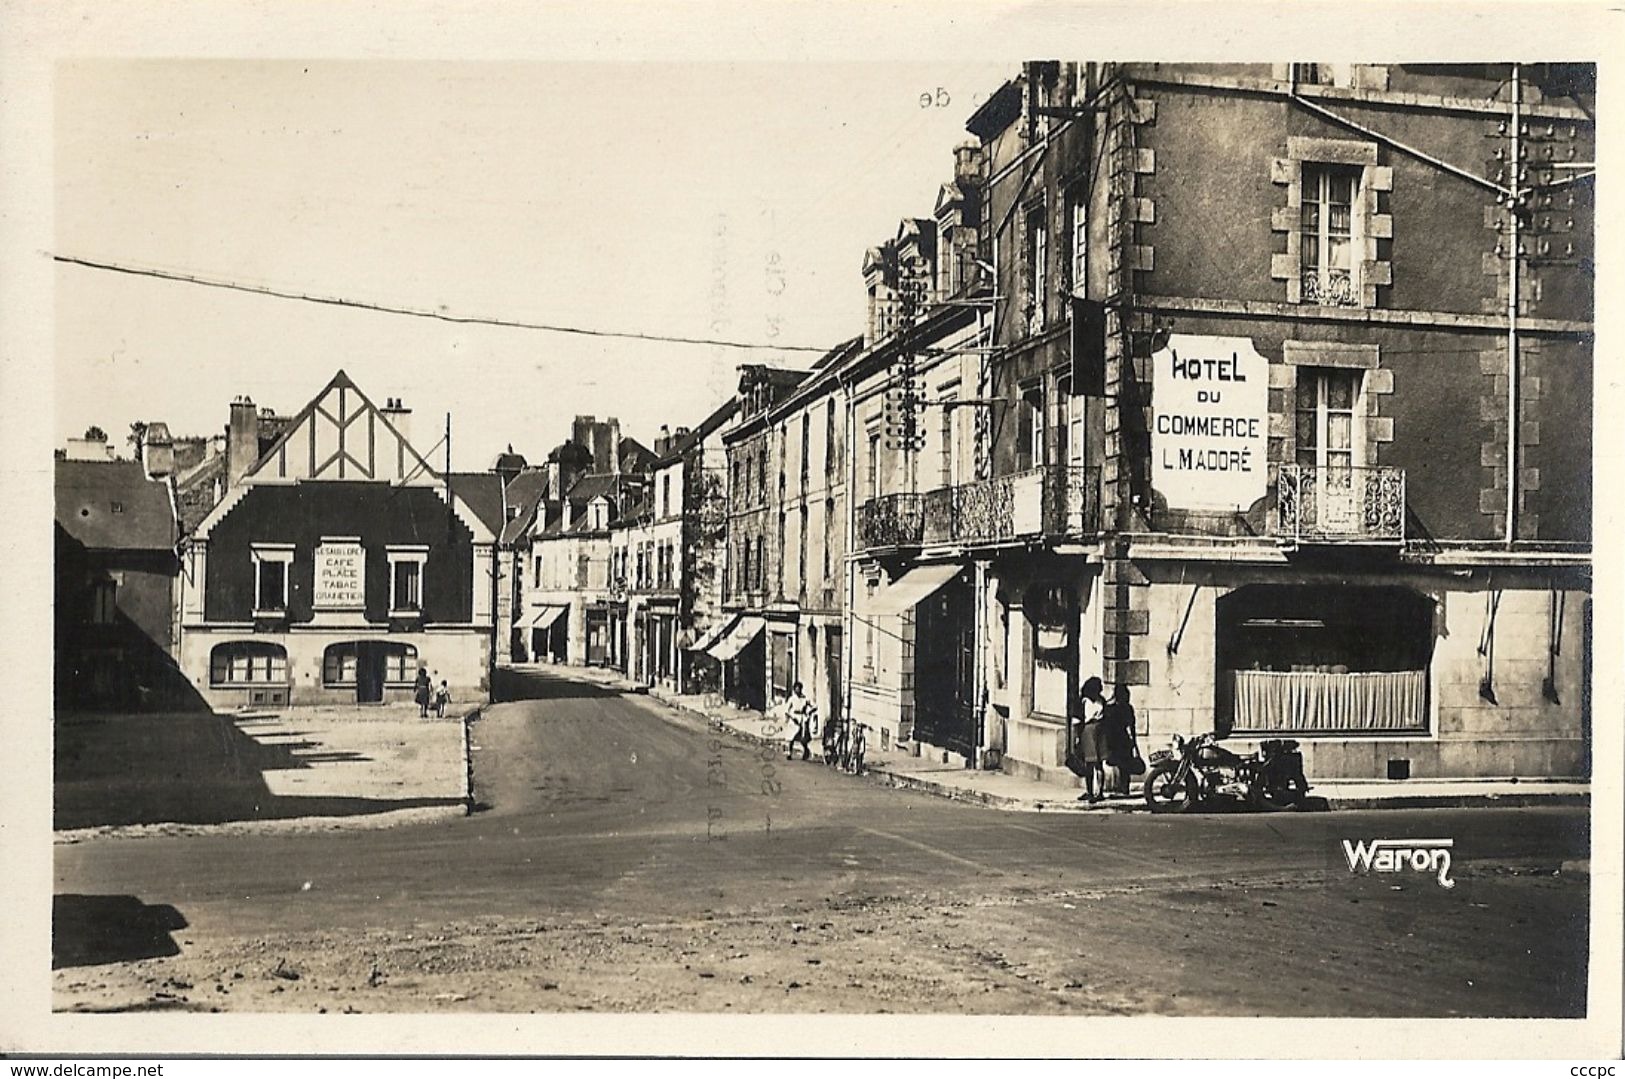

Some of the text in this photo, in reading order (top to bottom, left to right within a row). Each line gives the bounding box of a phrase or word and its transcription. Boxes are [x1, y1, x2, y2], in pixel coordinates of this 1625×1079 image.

[1172, 348, 1246, 382] HOTEL
[1197, 391, 1220, 403] DU
[1157, 414, 1259, 438] COMMERCE
[322, 569, 357, 578] PLACE
[323, 580, 357, 589] TABAC
